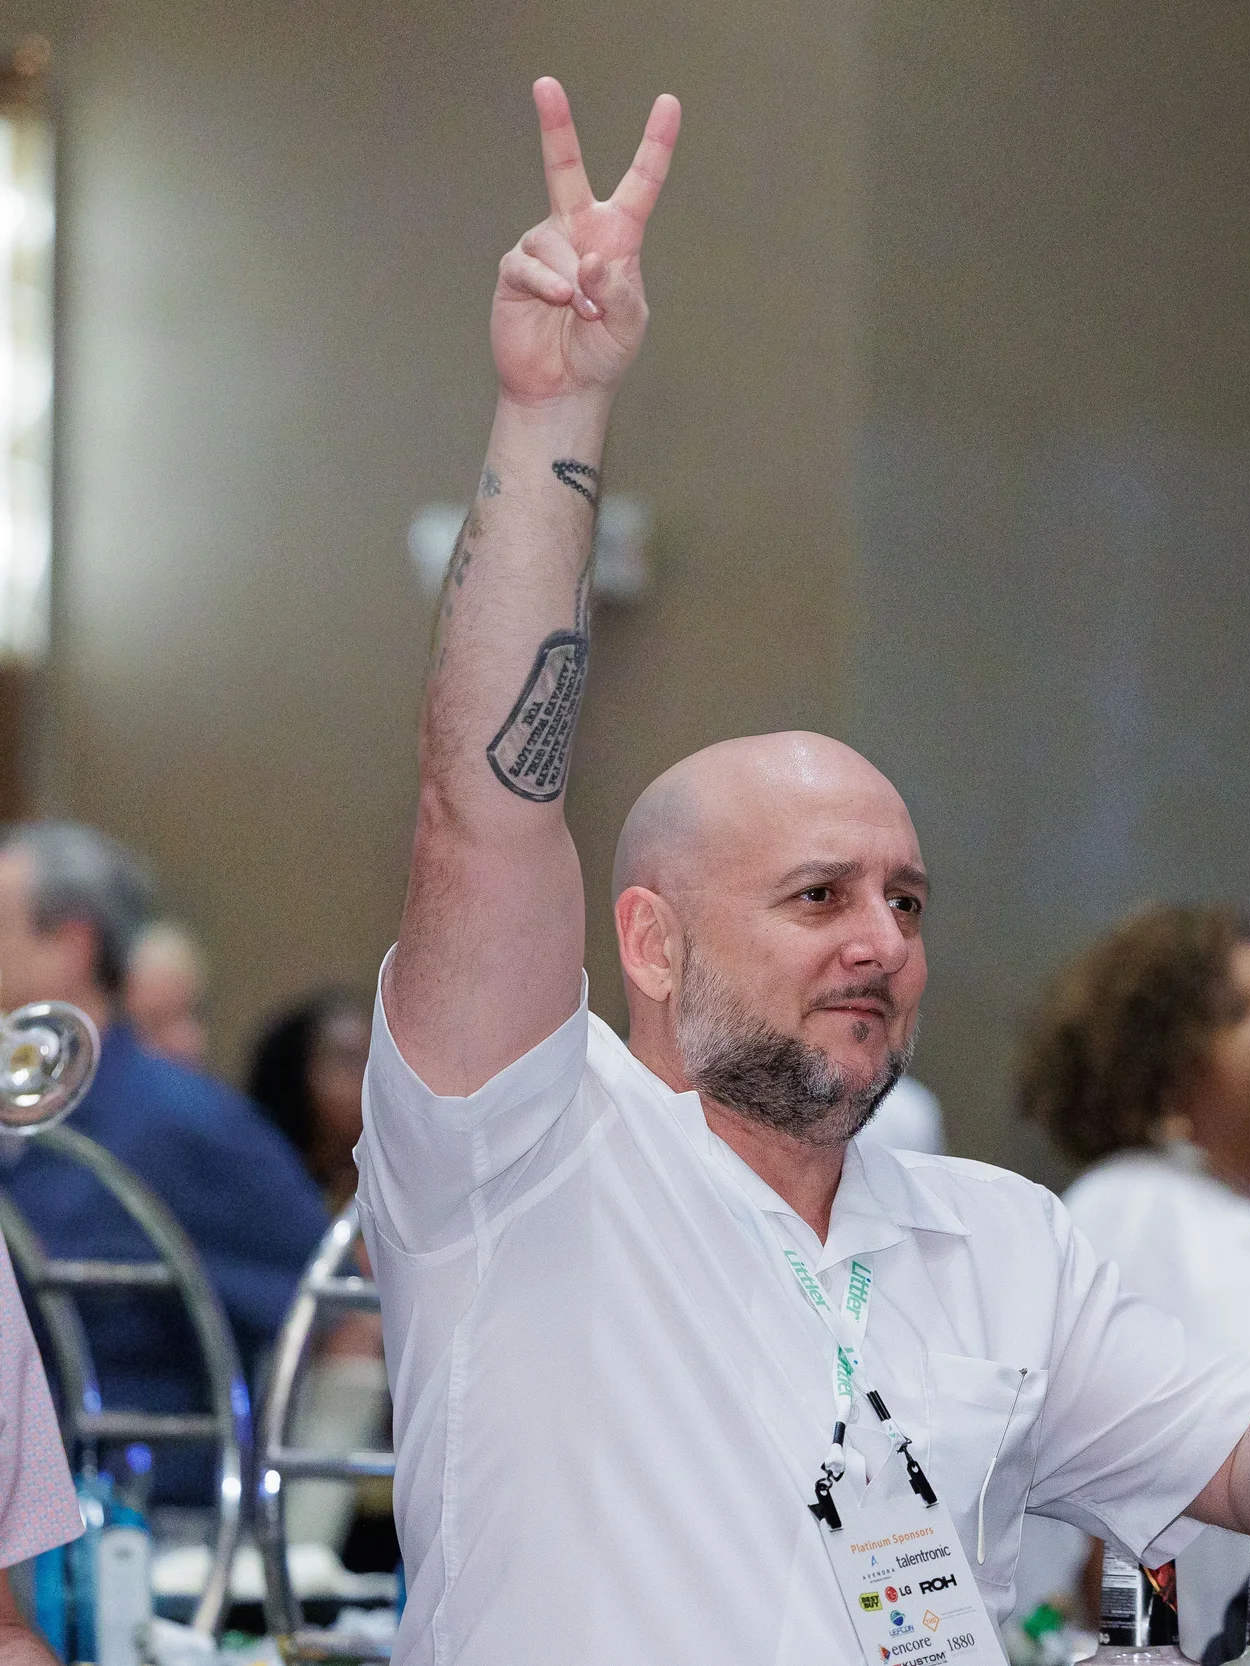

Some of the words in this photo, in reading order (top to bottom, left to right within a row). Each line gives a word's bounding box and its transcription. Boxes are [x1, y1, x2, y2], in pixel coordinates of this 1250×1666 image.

[543, 664, 570, 716] ALWAYS
[562, 668, 578, 703] YOUR
[526, 717, 549, 747] WILL
[541, 703, 566, 748] LITTLE
[507, 746, 532, 777] LOVE
[784, 1250, 832, 1312] Littler
[846, 1260, 872, 1321] Littler
[851, 1537, 891, 1554] Platinum
[892, 1526, 934, 1545] Sponsors
[896, 1544, 951, 1568] talentronic
[862, 1568, 896, 1580] AVENDRA
[919, 1574, 957, 1595] ROH
[861, 1595, 879, 1603] BEST
[899, 1585, 912, 1597] LG
[864, 1601, 879, 1609] BUY
[891, 1637, 932, 1656] encore
[947, 1633, 975, 1652] 1880
